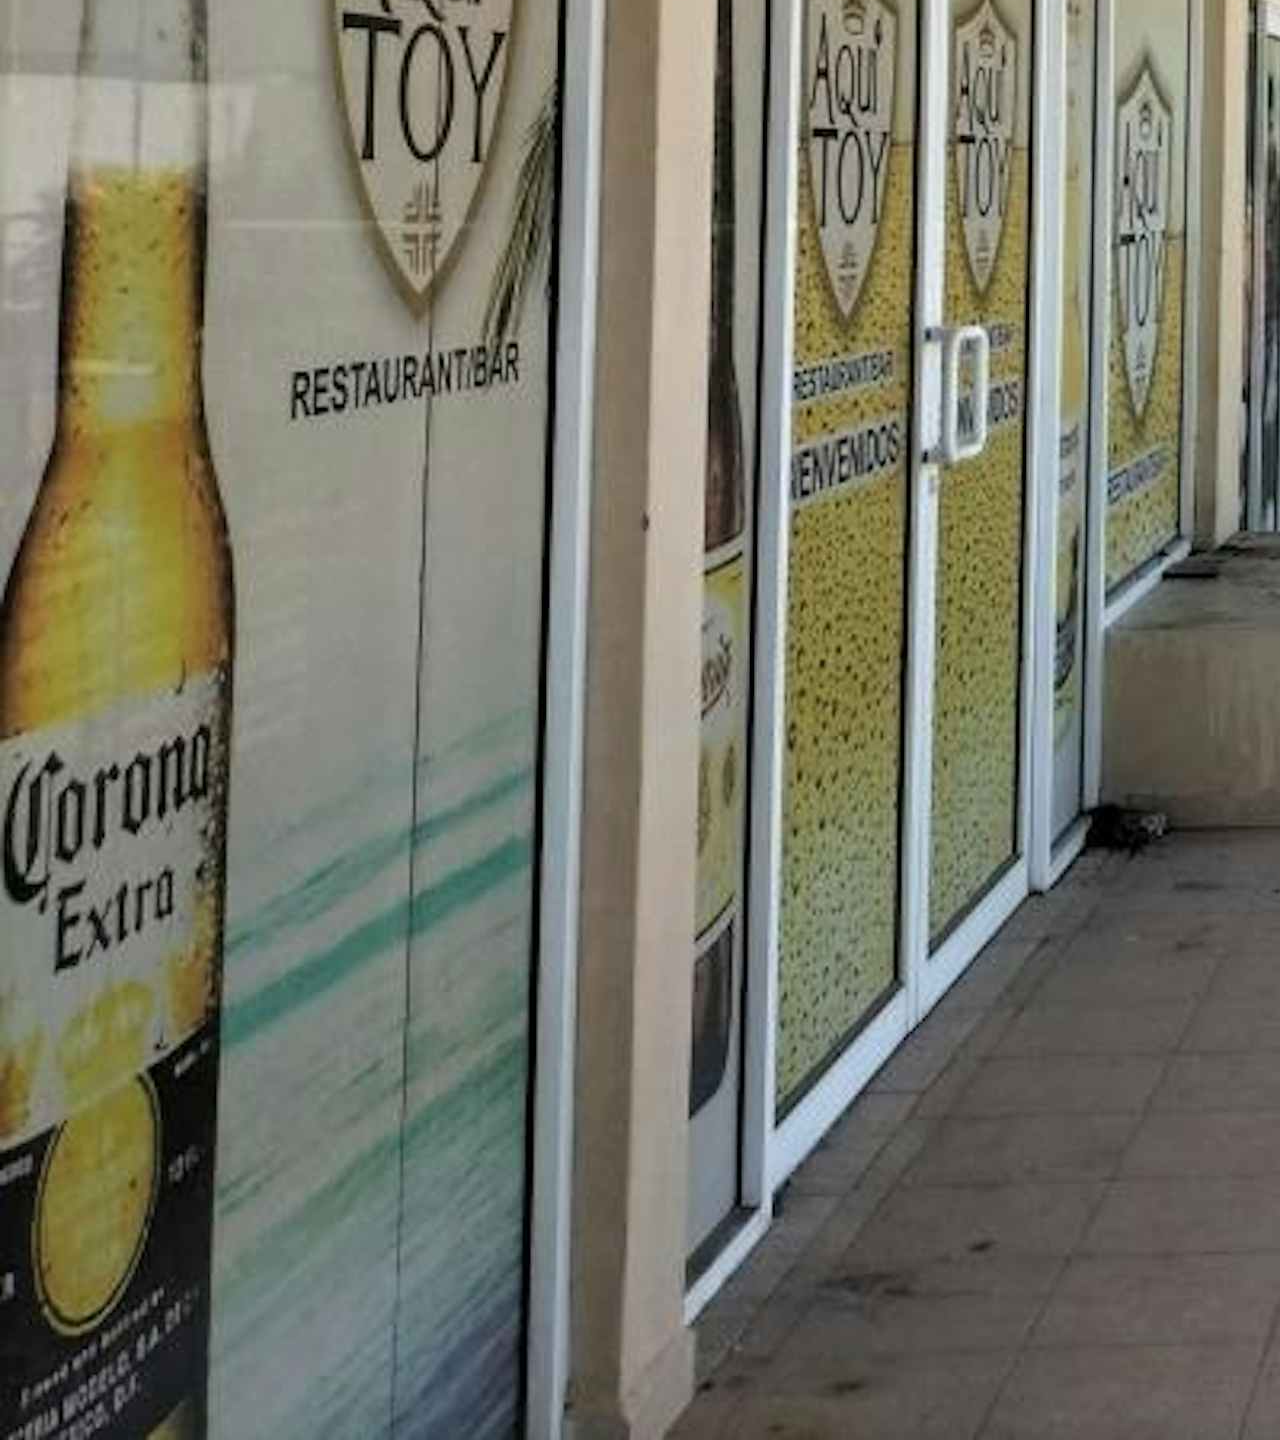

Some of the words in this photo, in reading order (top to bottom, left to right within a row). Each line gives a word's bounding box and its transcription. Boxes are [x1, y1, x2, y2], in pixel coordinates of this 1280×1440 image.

[342, 11, 506, 163] TOY
[812, 127, 888, 228] TOY
[3, 723, 211, 915] Corona
[53, 864, 174, 975] Extra
